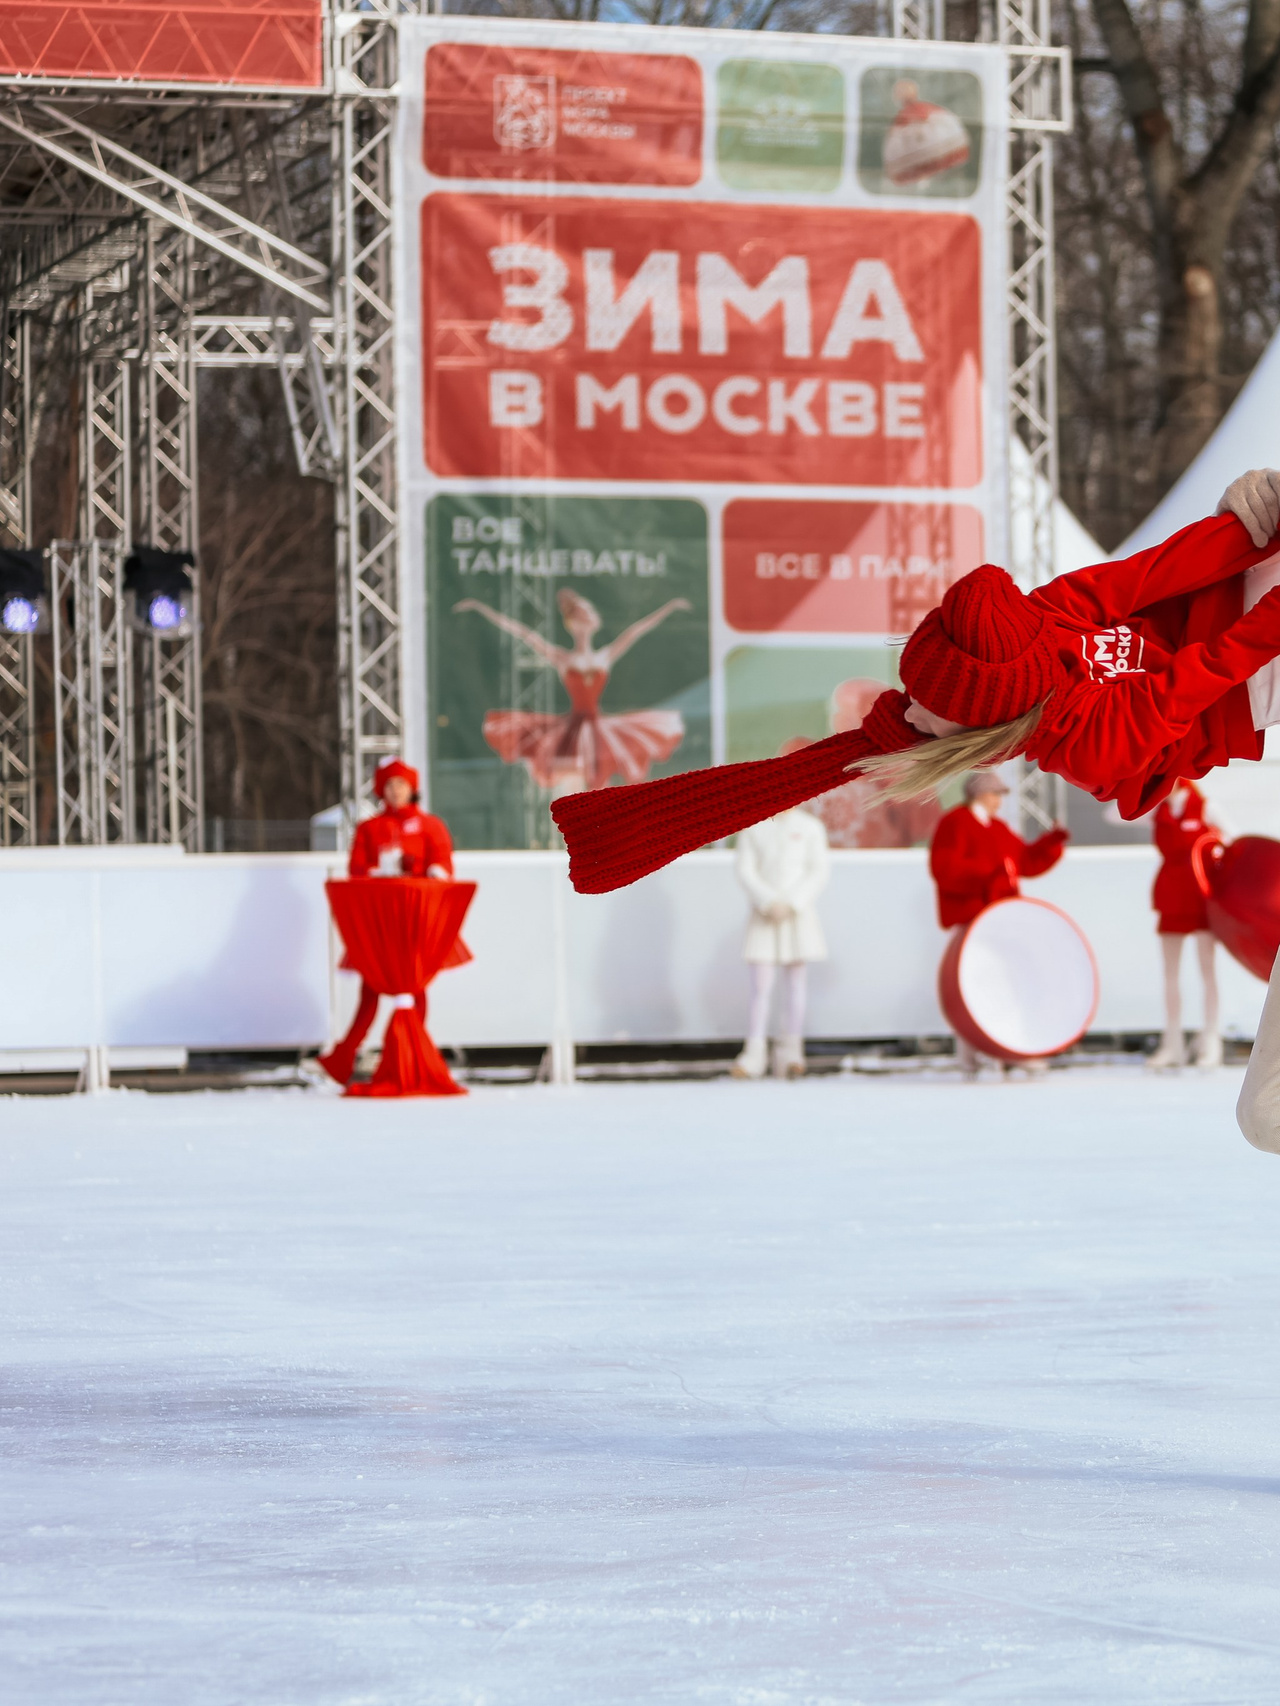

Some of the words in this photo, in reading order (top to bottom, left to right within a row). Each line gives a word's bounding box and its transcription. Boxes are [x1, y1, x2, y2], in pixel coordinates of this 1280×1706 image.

[486, 242, 925, 363] ЗИМА
[489, 369, 544, 428] В
[575, 373, 926, 439] МОСКВЕ
[452, 548, 667, 577] ТАНЦЕВАТЬ!
[755, 552, 821, 580] ВСЕ
[829, 553, 854, 580] В
